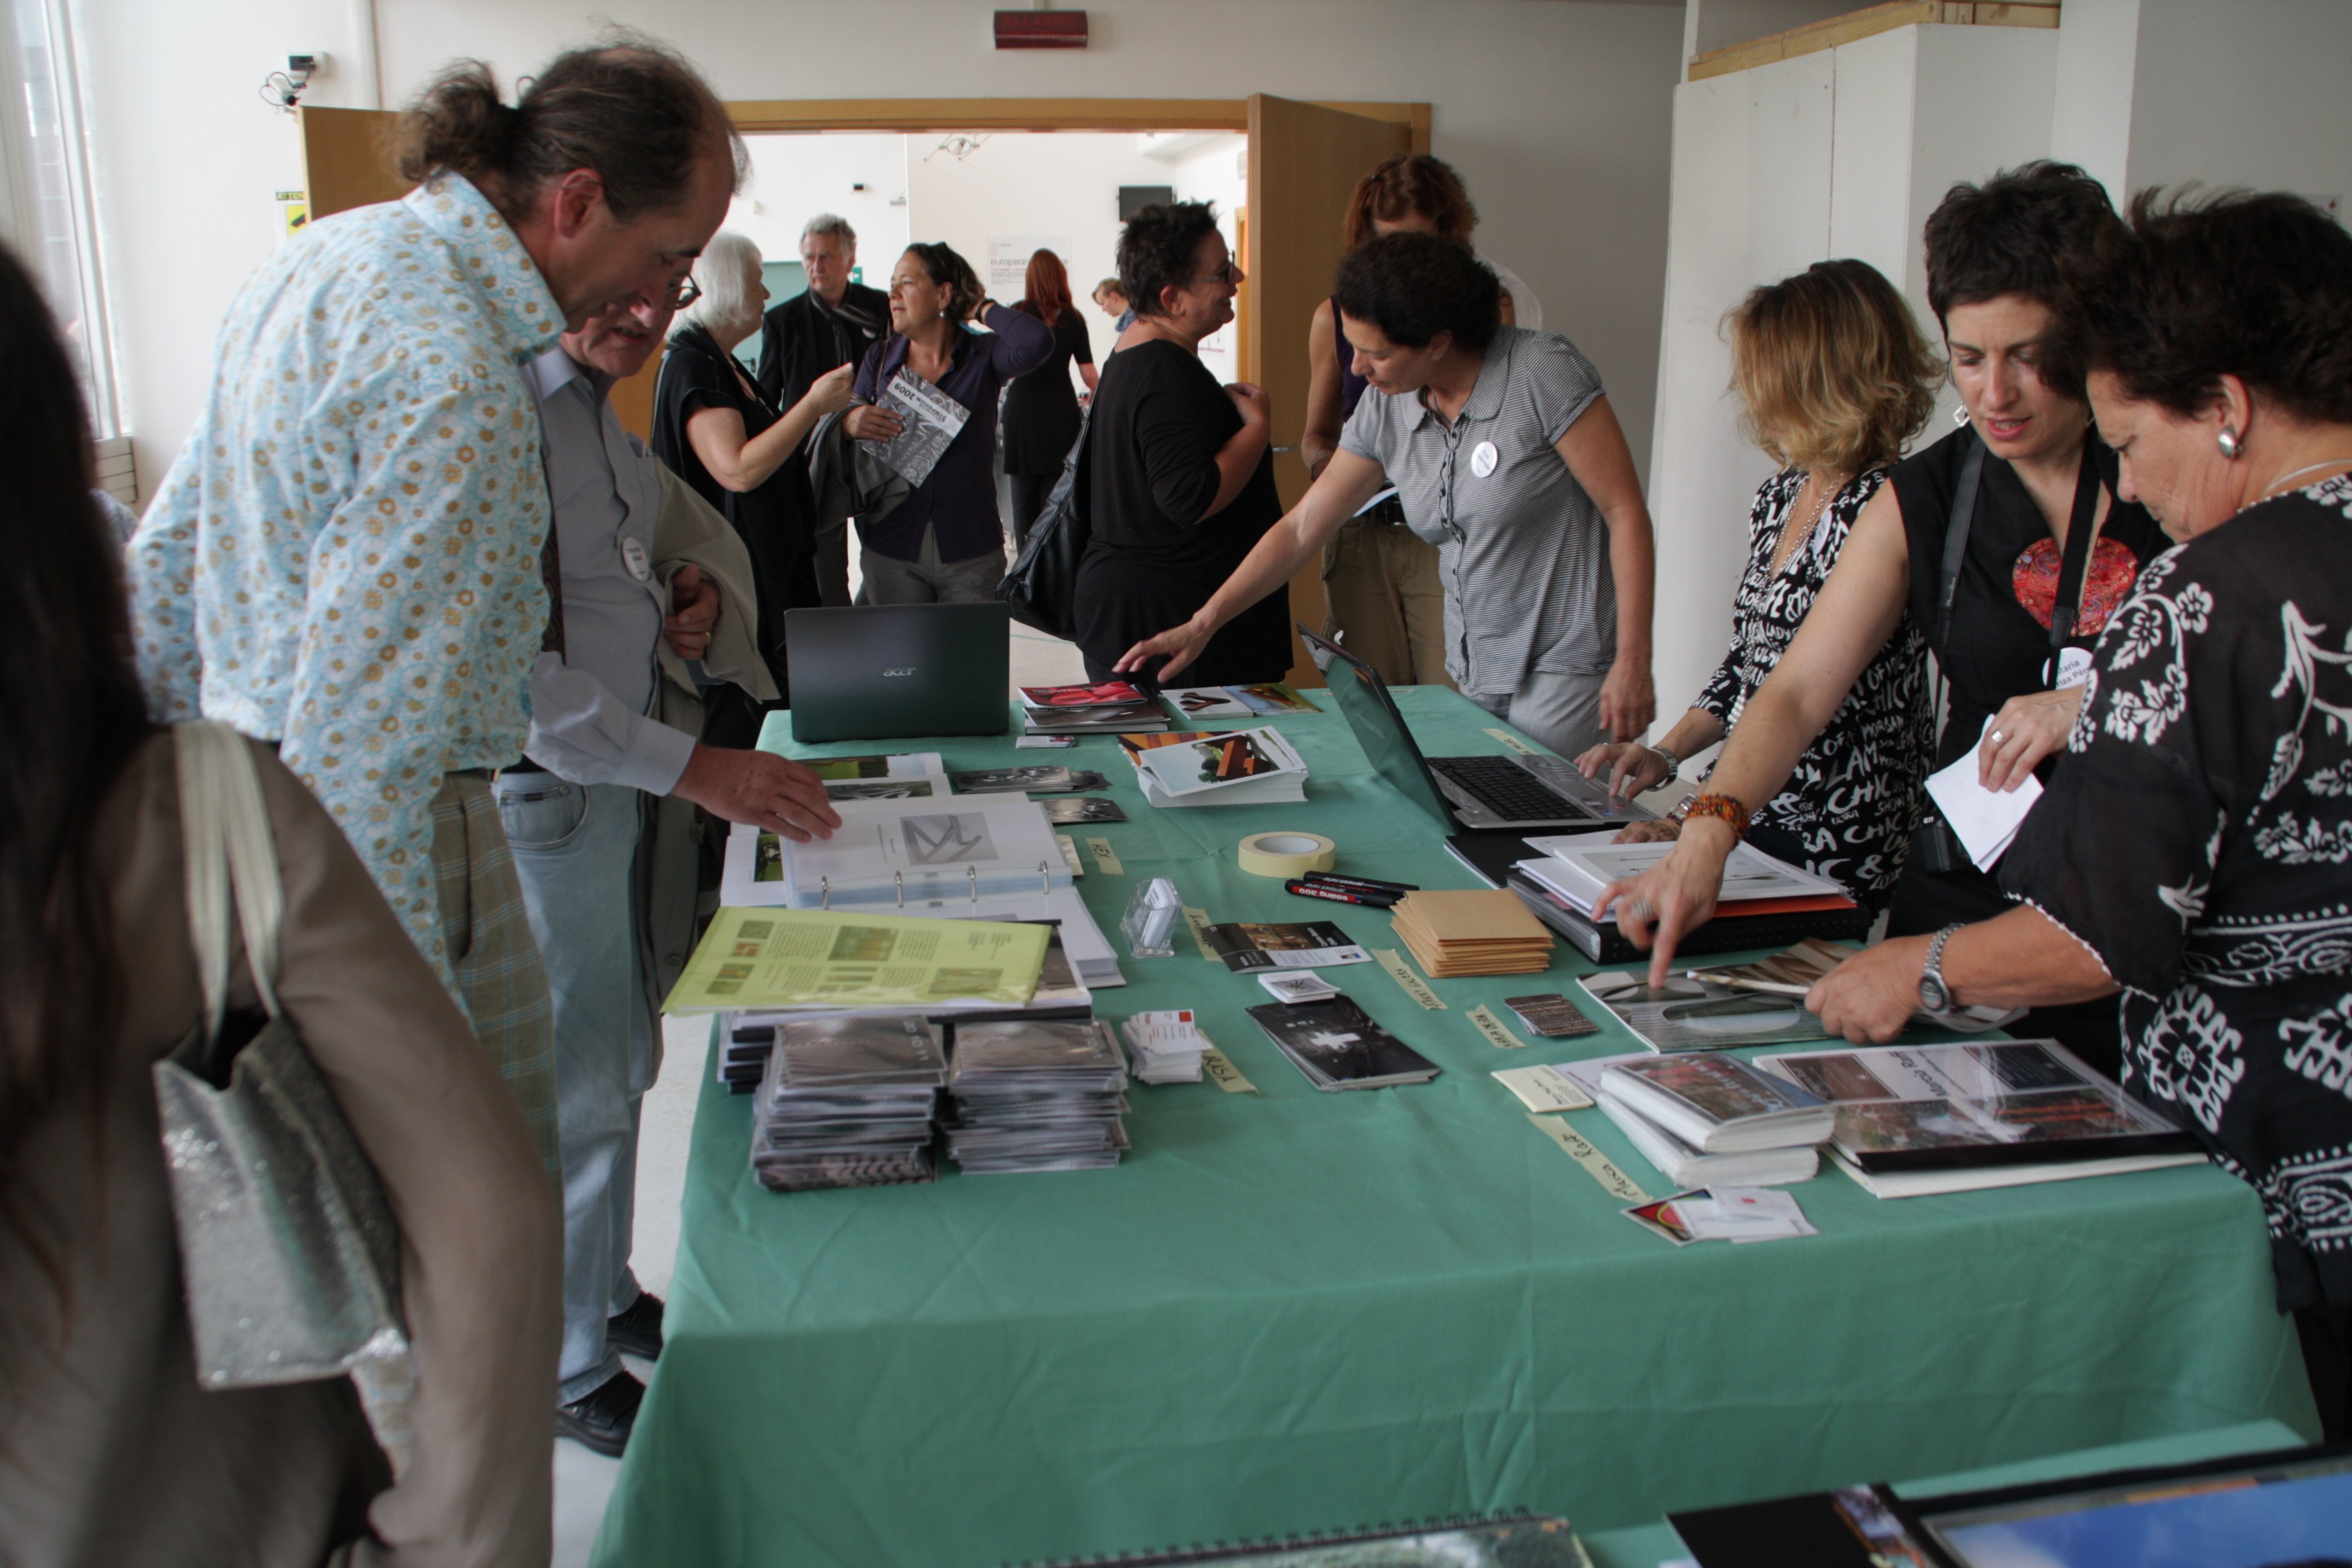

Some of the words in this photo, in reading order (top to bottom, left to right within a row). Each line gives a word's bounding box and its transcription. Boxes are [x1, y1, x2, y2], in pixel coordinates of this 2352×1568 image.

[894, 382, 915, 400] 2009
[883, 667, 916, 676] acer
[1298, 888, 1318, 897] 300
[1319, 891, 1348, 901] edding
